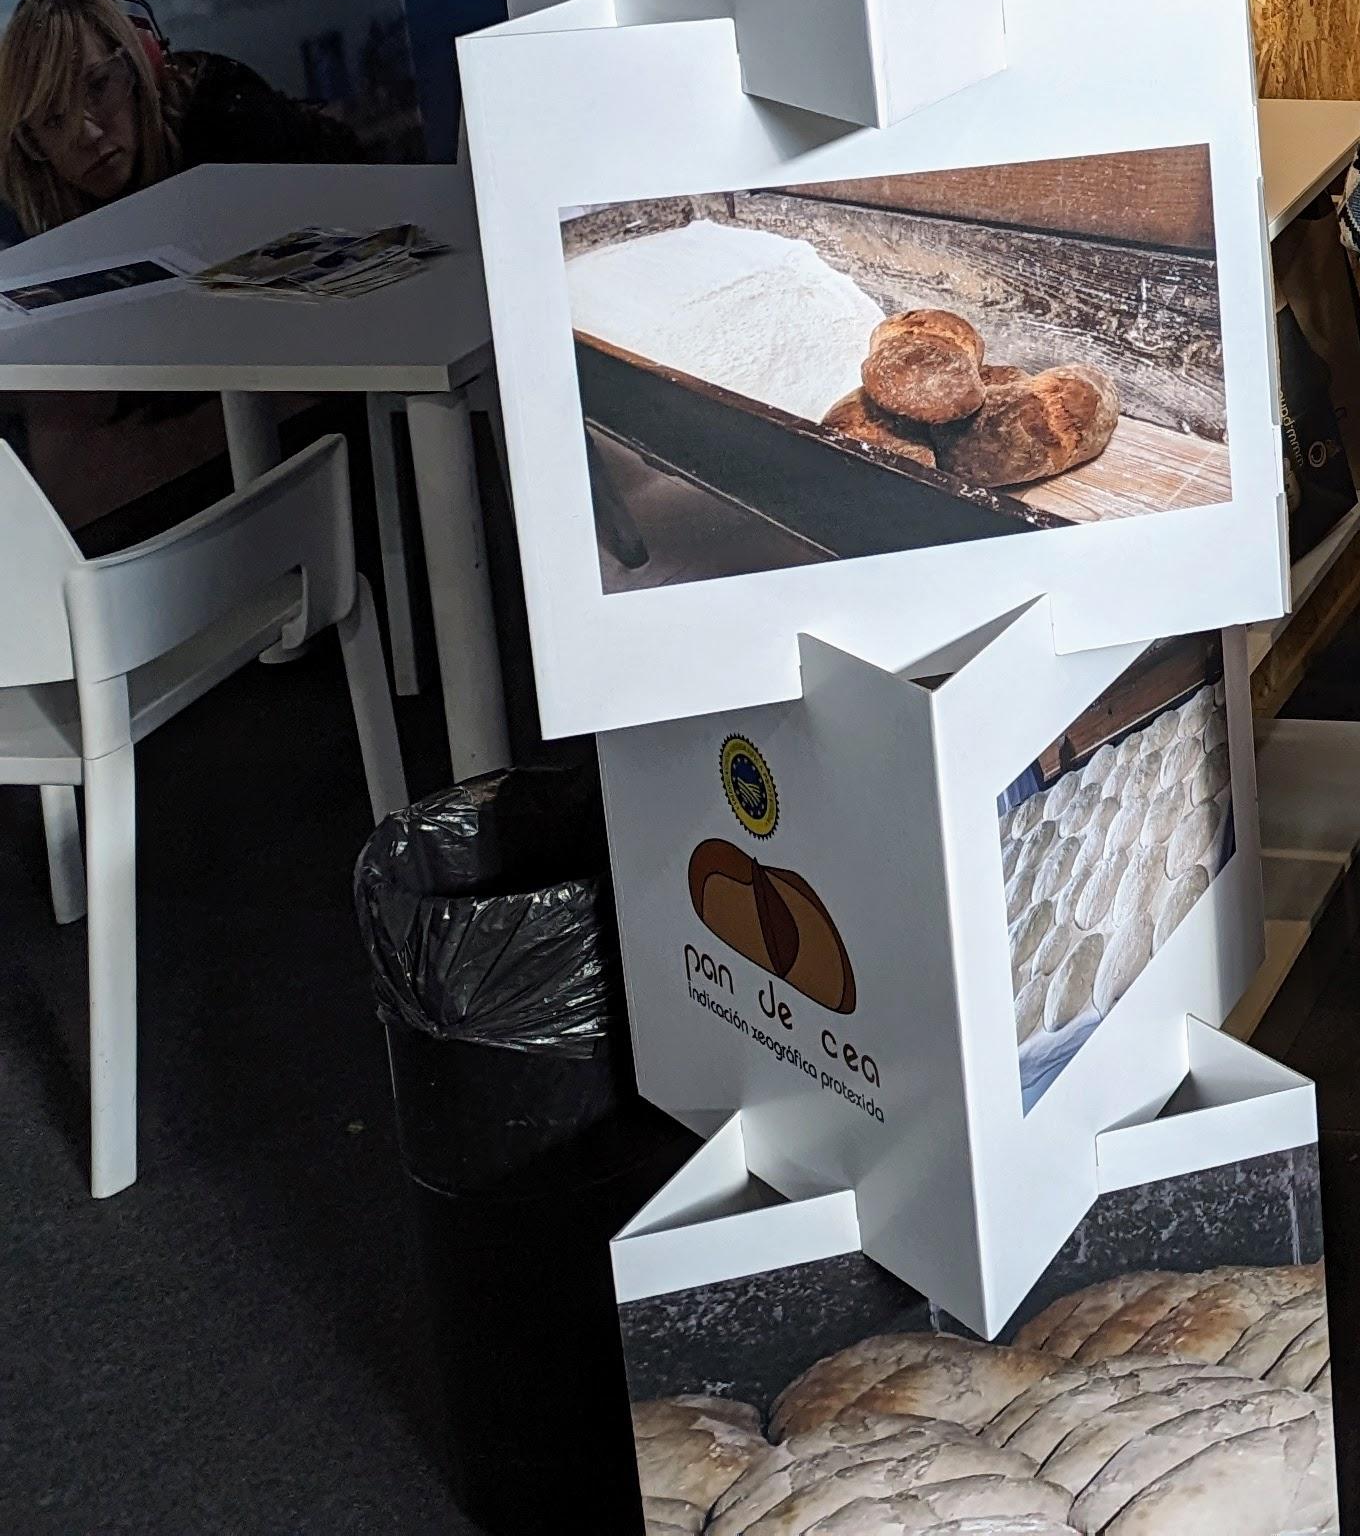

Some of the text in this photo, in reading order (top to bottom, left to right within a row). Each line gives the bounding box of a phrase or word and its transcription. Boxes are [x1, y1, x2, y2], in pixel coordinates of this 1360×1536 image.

[684, 944, 881, 1088] pan de cea
[689, 982, 885, 1124] indicación xeográfica protexida
